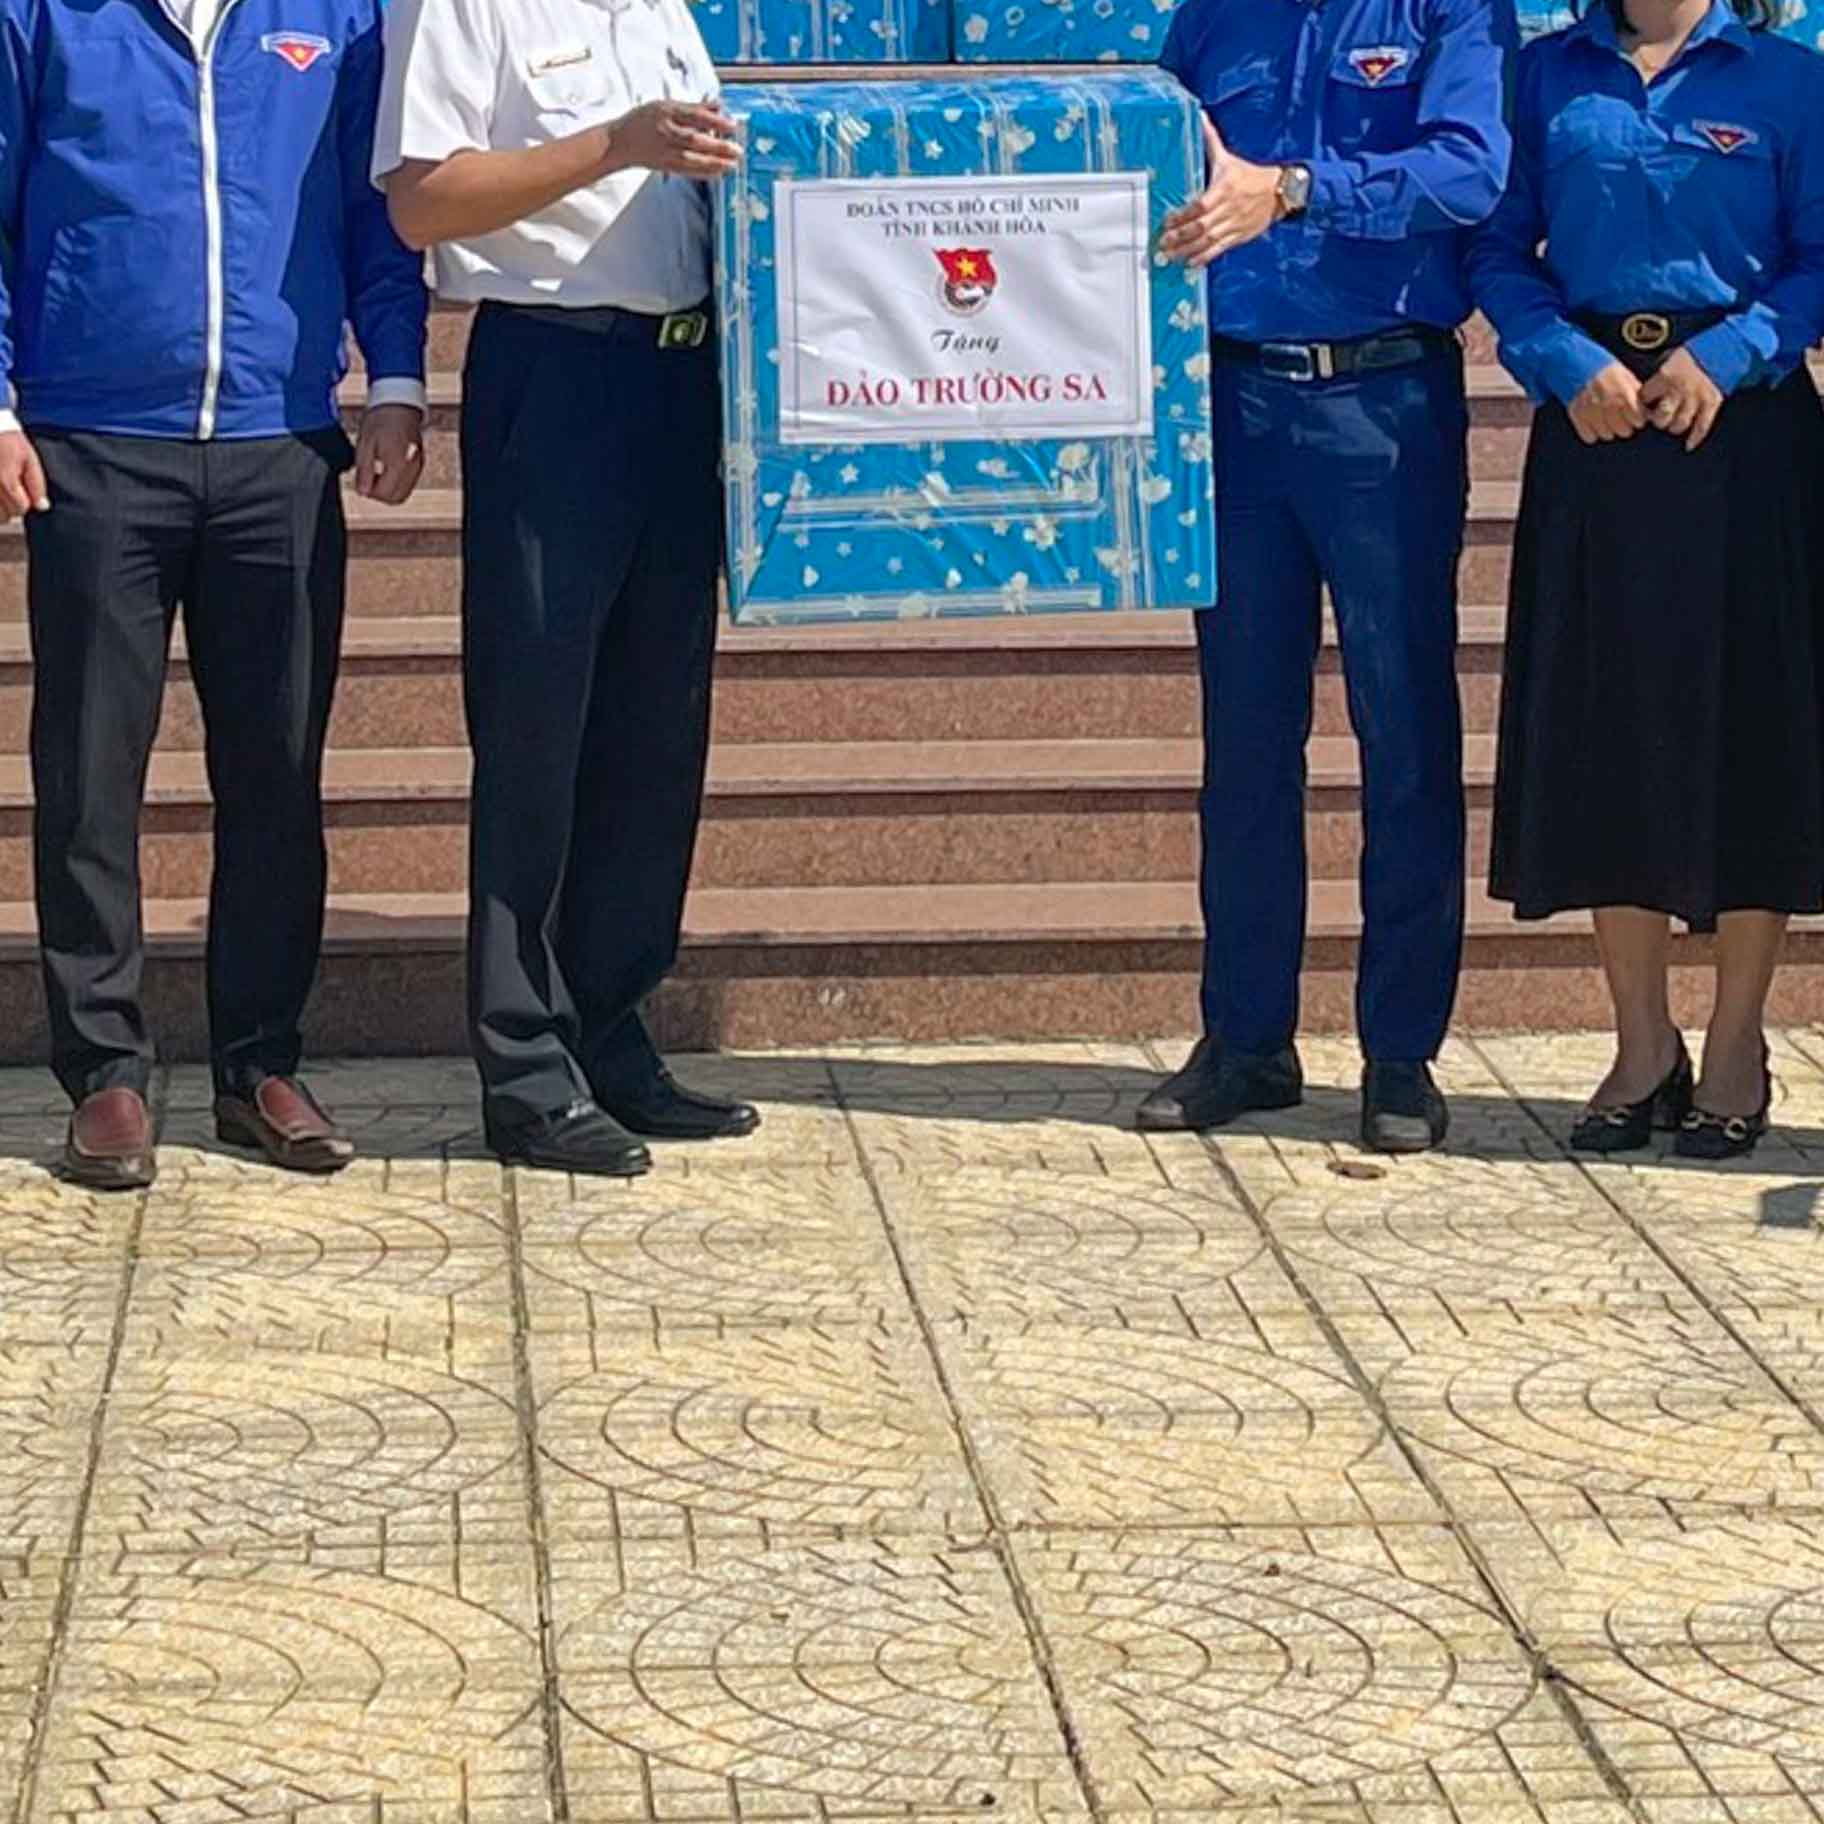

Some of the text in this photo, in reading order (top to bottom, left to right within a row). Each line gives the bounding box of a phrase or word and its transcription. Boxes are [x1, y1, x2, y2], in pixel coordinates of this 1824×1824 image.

[827, 369, 1106, 407] ĐẢO TRƯỜNG SA
